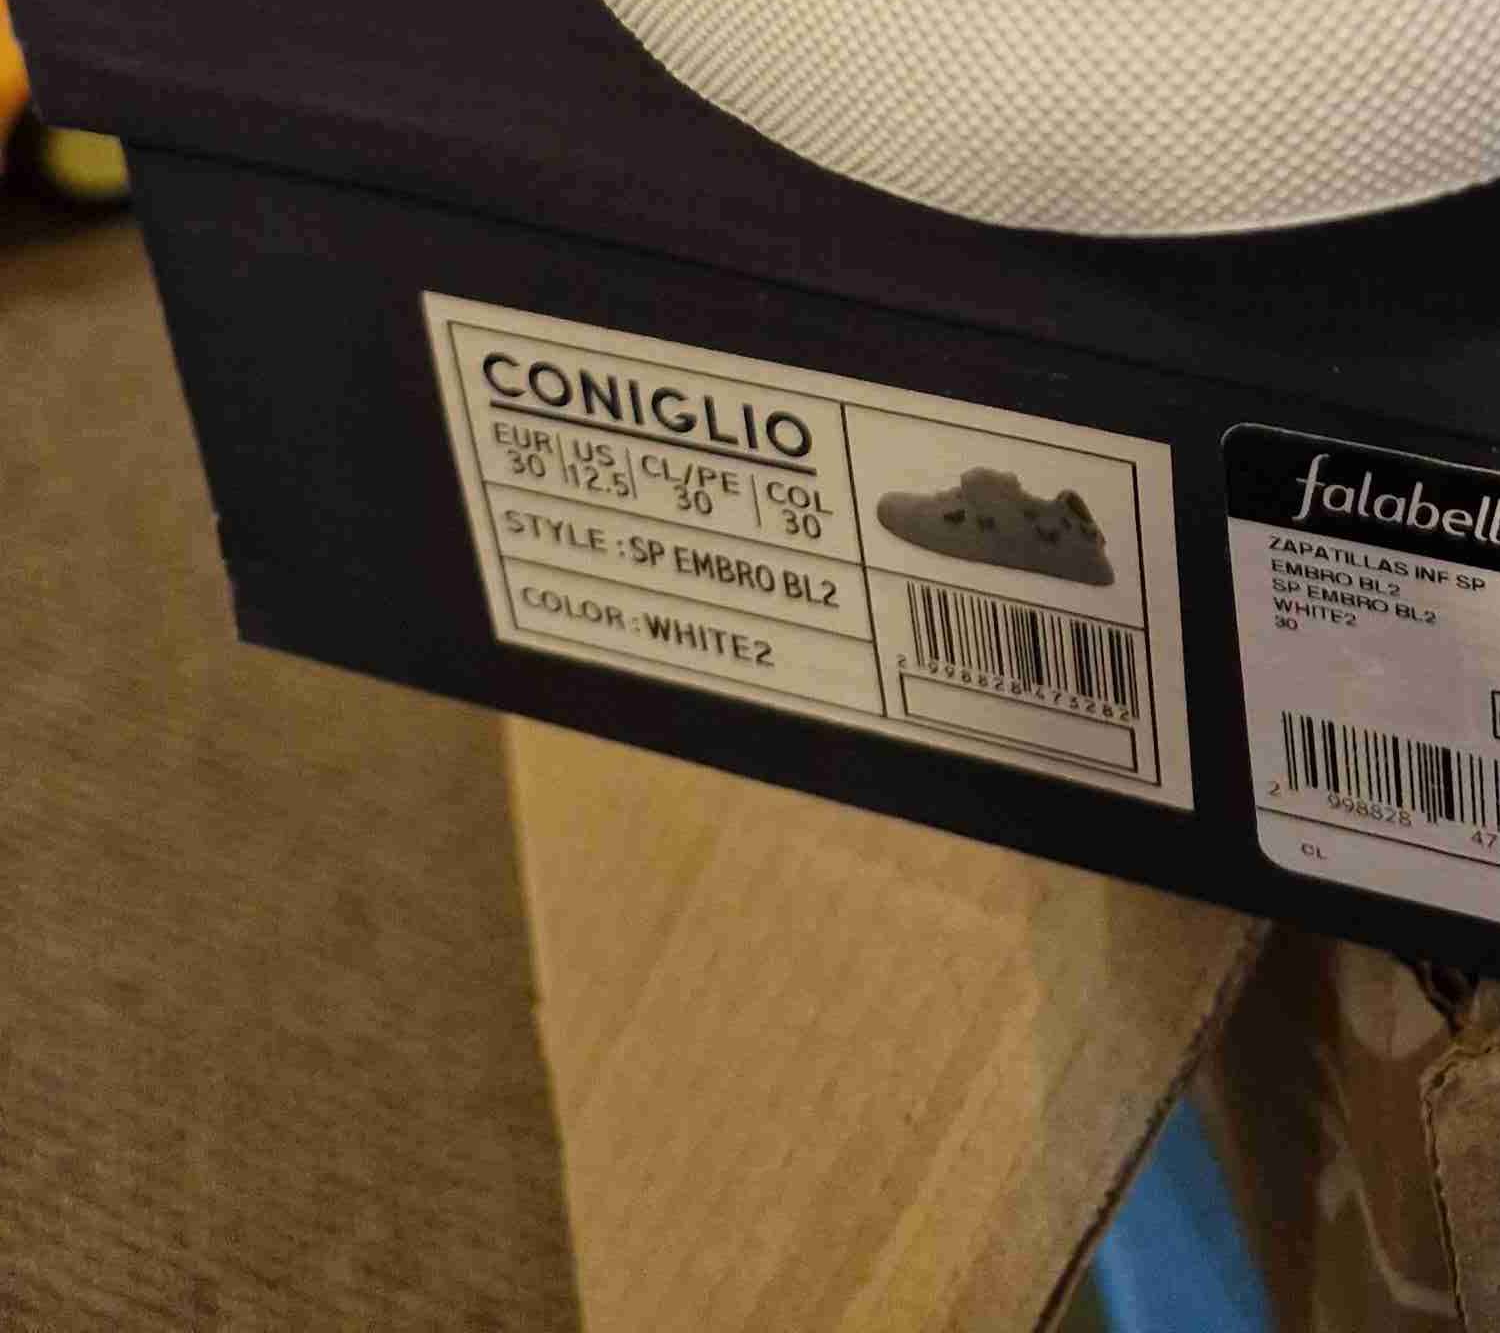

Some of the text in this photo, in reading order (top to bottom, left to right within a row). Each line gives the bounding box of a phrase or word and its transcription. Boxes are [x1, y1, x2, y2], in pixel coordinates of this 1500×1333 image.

[482, 351, 813, 458] CONIGLIO
[493, 422, 834, 515] EUR US CL/PE COL
[506, 450, 822, 539] 30 12.5 30 30
[504, 509, 609, 551] STYLE
[674, 546, 776, 593] EMBRO
[783, 570, 841, 609] BL2
[1269, 535, 1486, 592] ZAPATILLAS INF SP
[1271, 558, 1401, 596] EMBRO BL2
[521, 586, 627, 629] COLOR
[1272, 578, 1437, 624] SP EMBRO BL2
[1273, 596, 1357, 627] WHITE2
[1274, 614, 1299, 631] 30
[1268, 782, 1281, 797] 2
[1327, 793, 1413, 828] 998828
